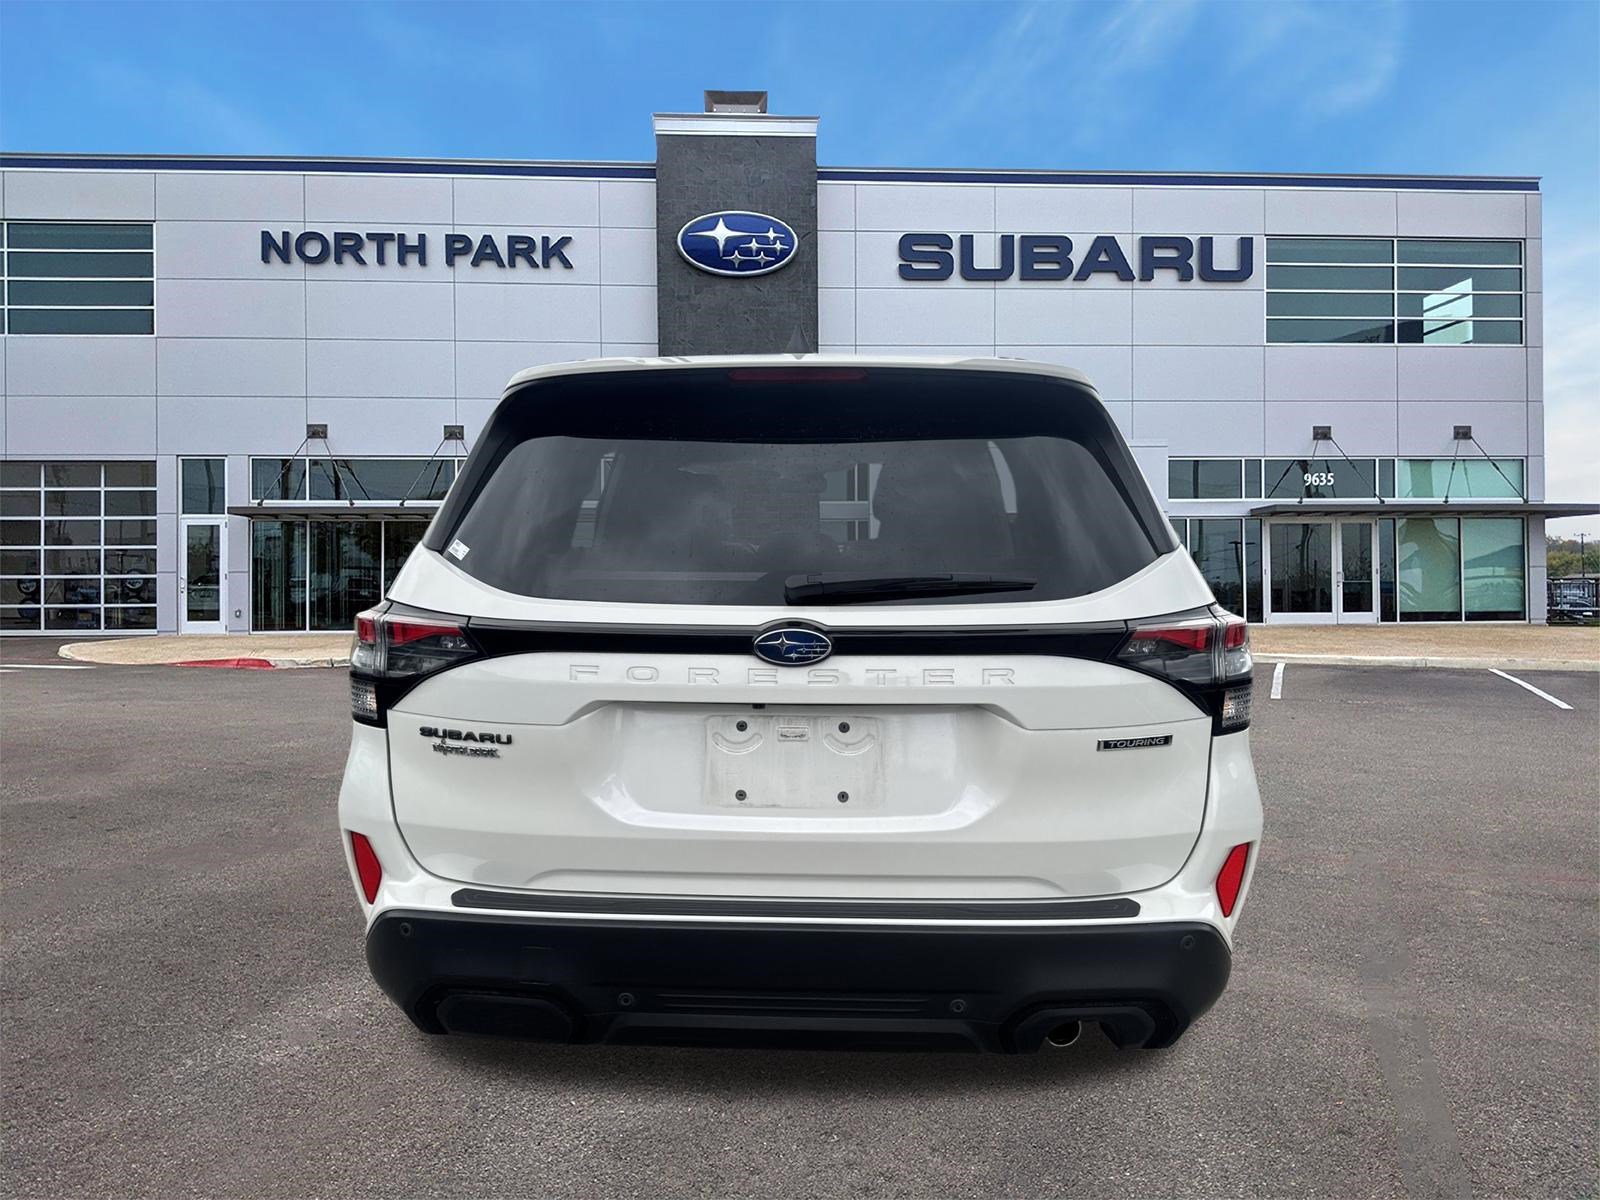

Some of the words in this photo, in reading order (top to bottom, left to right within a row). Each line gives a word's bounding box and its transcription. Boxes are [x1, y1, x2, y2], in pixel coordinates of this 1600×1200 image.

[260, 230, 428, 266] NORTH
[445, 233, 574, 269] PARK
[898, 233, 1255, 283] SUBARU
[1303, 472, 1335, 486] 9635
[568, 664, 1017, 686] FORESTER
[419, 726, 513, 745] SUBARU
[1108, 737, 1167, 749] TOURING
